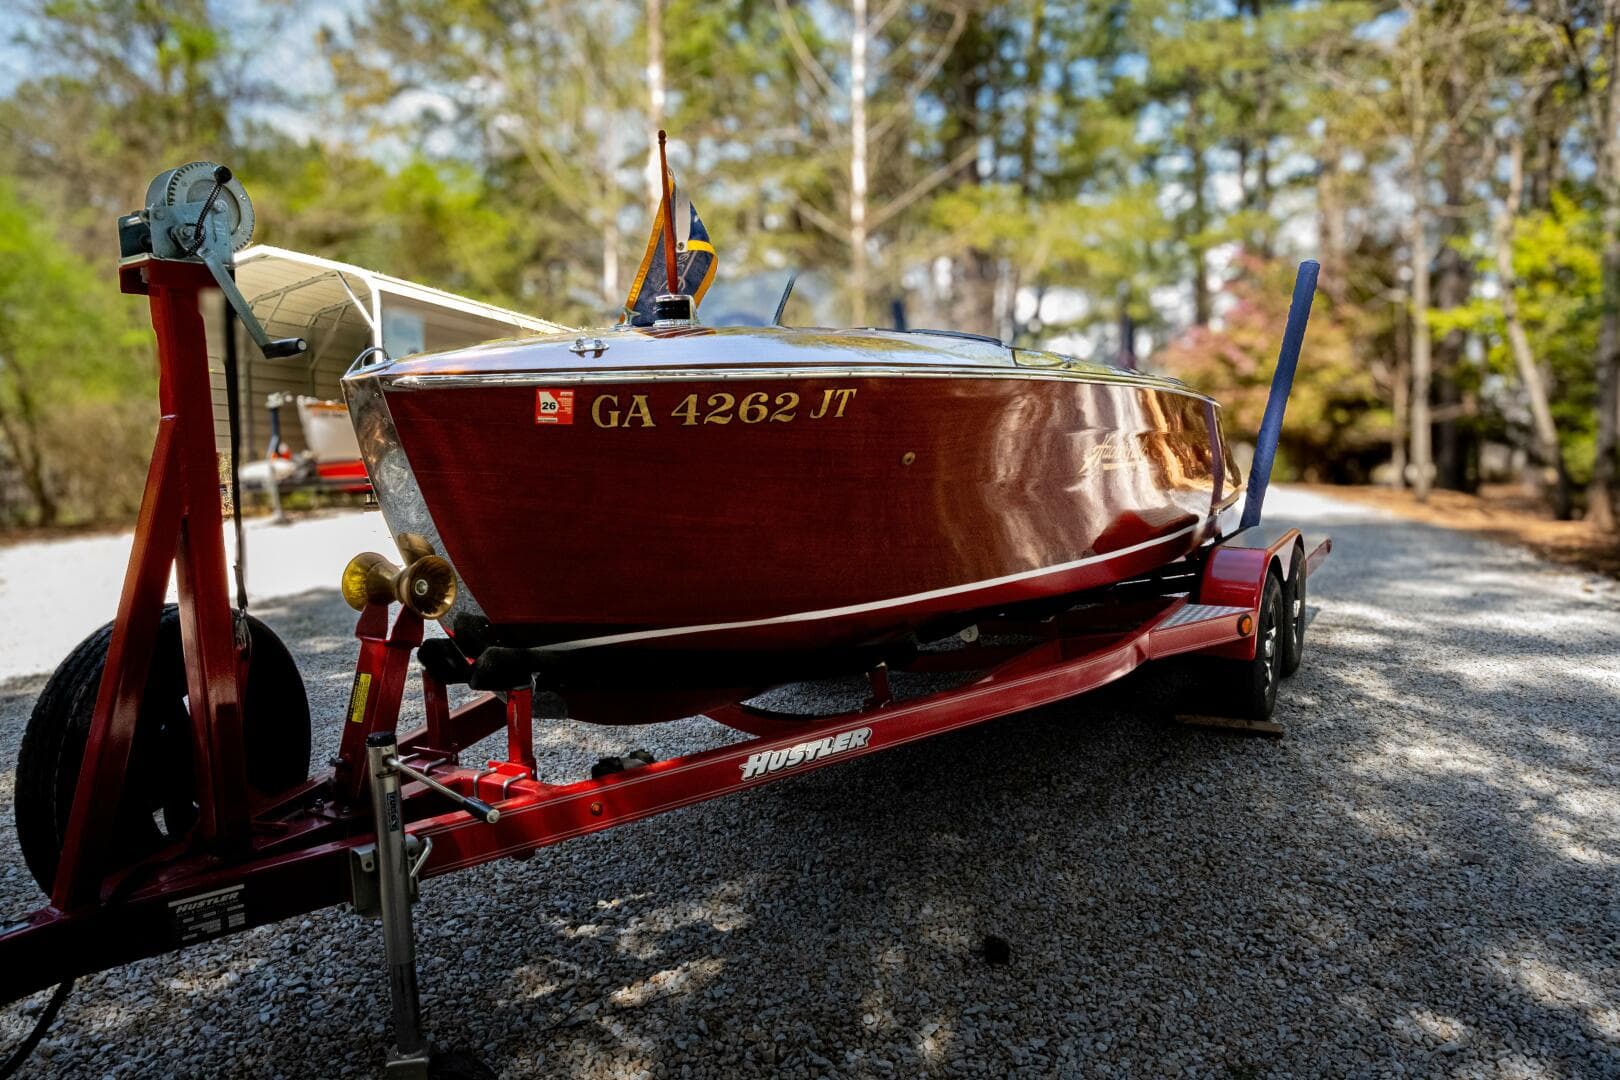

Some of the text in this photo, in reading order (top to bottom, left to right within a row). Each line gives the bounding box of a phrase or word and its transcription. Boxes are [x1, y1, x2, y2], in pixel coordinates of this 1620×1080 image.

[542, 401, 556, 410] 26
[591, 394, 656, 428] GA
[670, 391, 800, 426] 4262
[809, 388, 858, 419] JT
[739, 727, 872, 780] HUSTLER
[176, 891, 240, 914] HUSTLER
